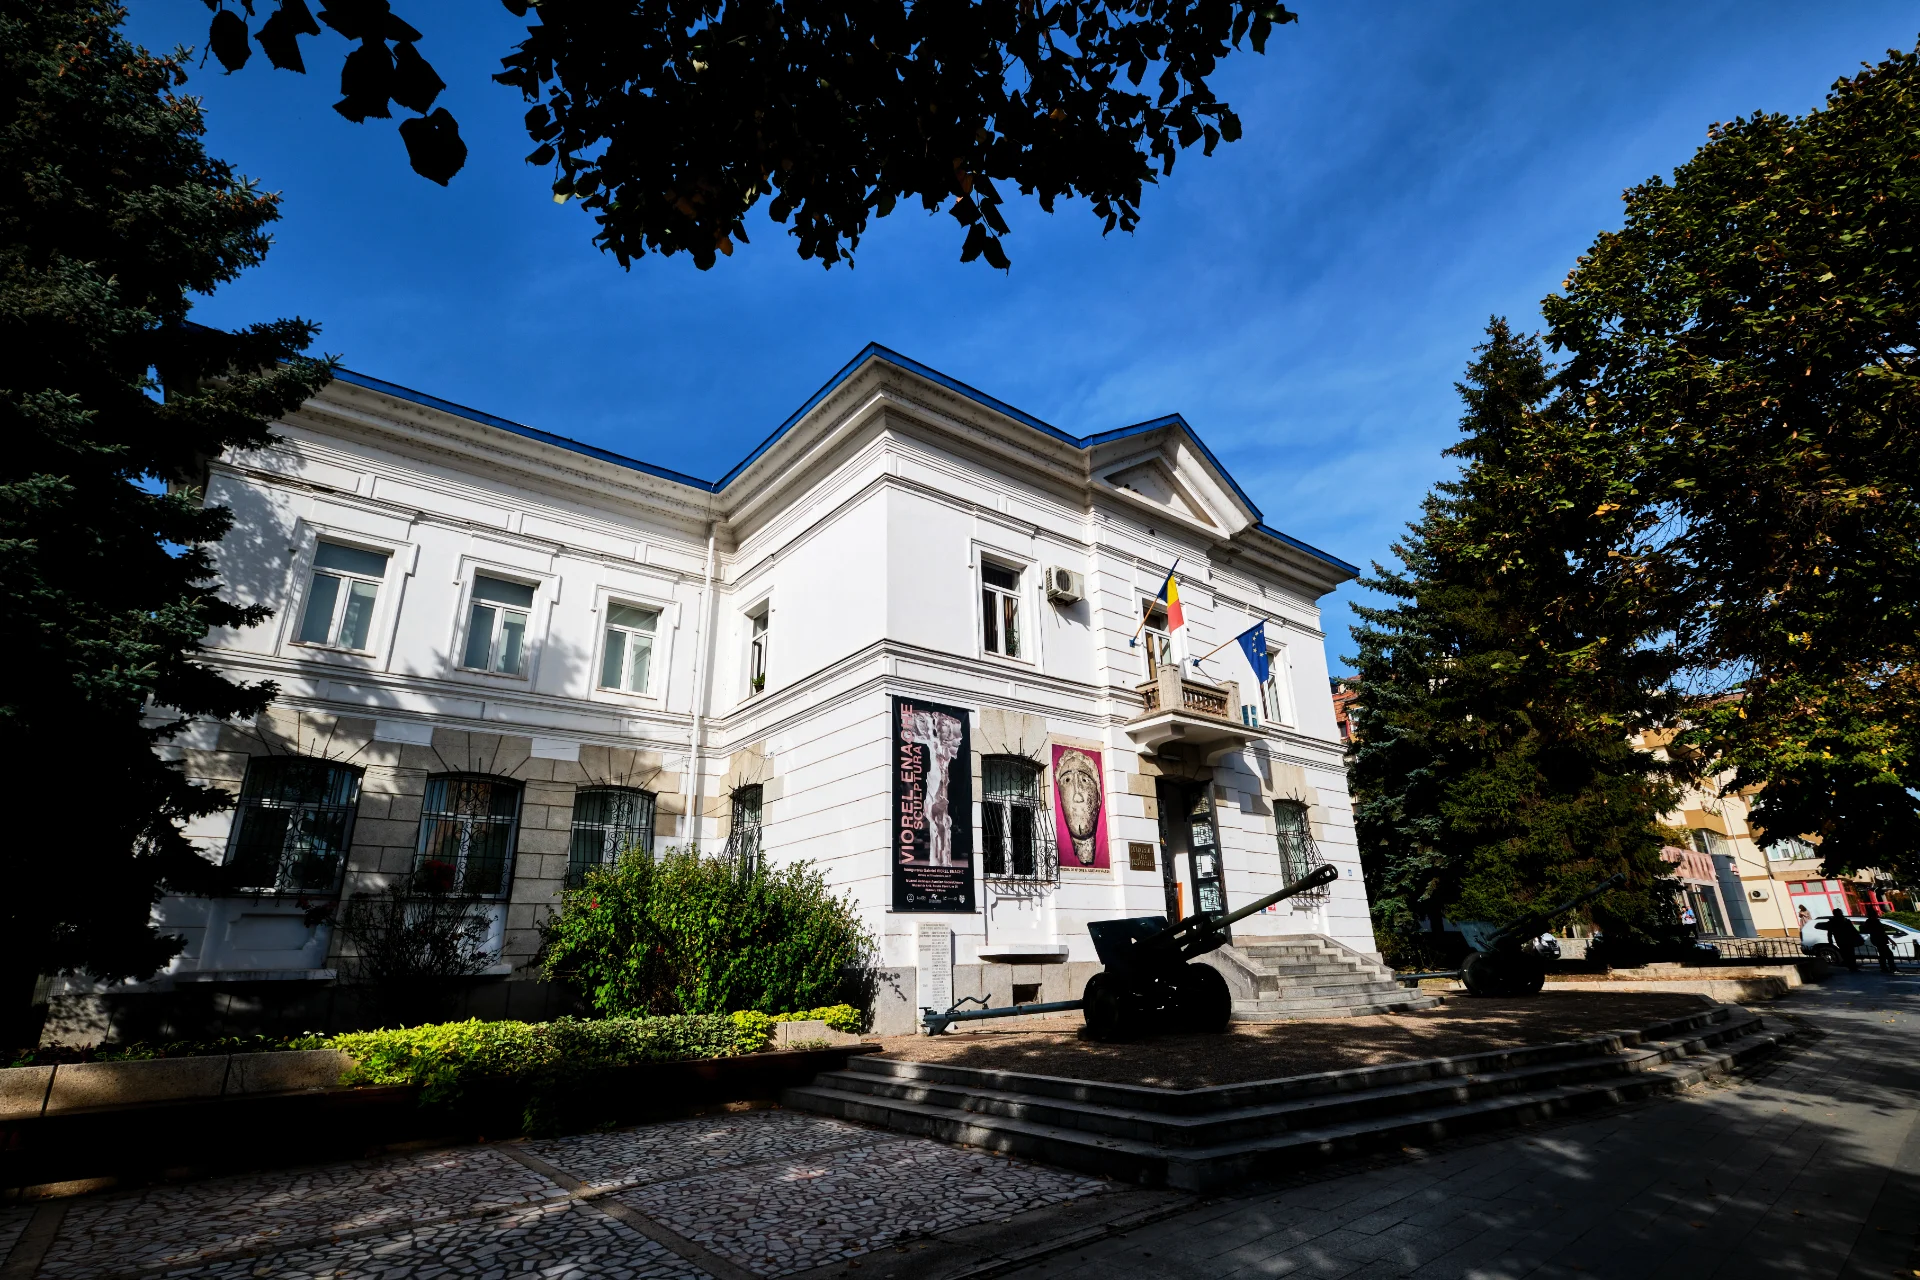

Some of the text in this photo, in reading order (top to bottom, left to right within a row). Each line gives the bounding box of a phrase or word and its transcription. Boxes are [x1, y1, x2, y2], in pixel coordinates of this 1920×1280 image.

[900, 703, 915, 864] VIOREL ENACHE
[913, 745, 924, 830] SCULPTURA
